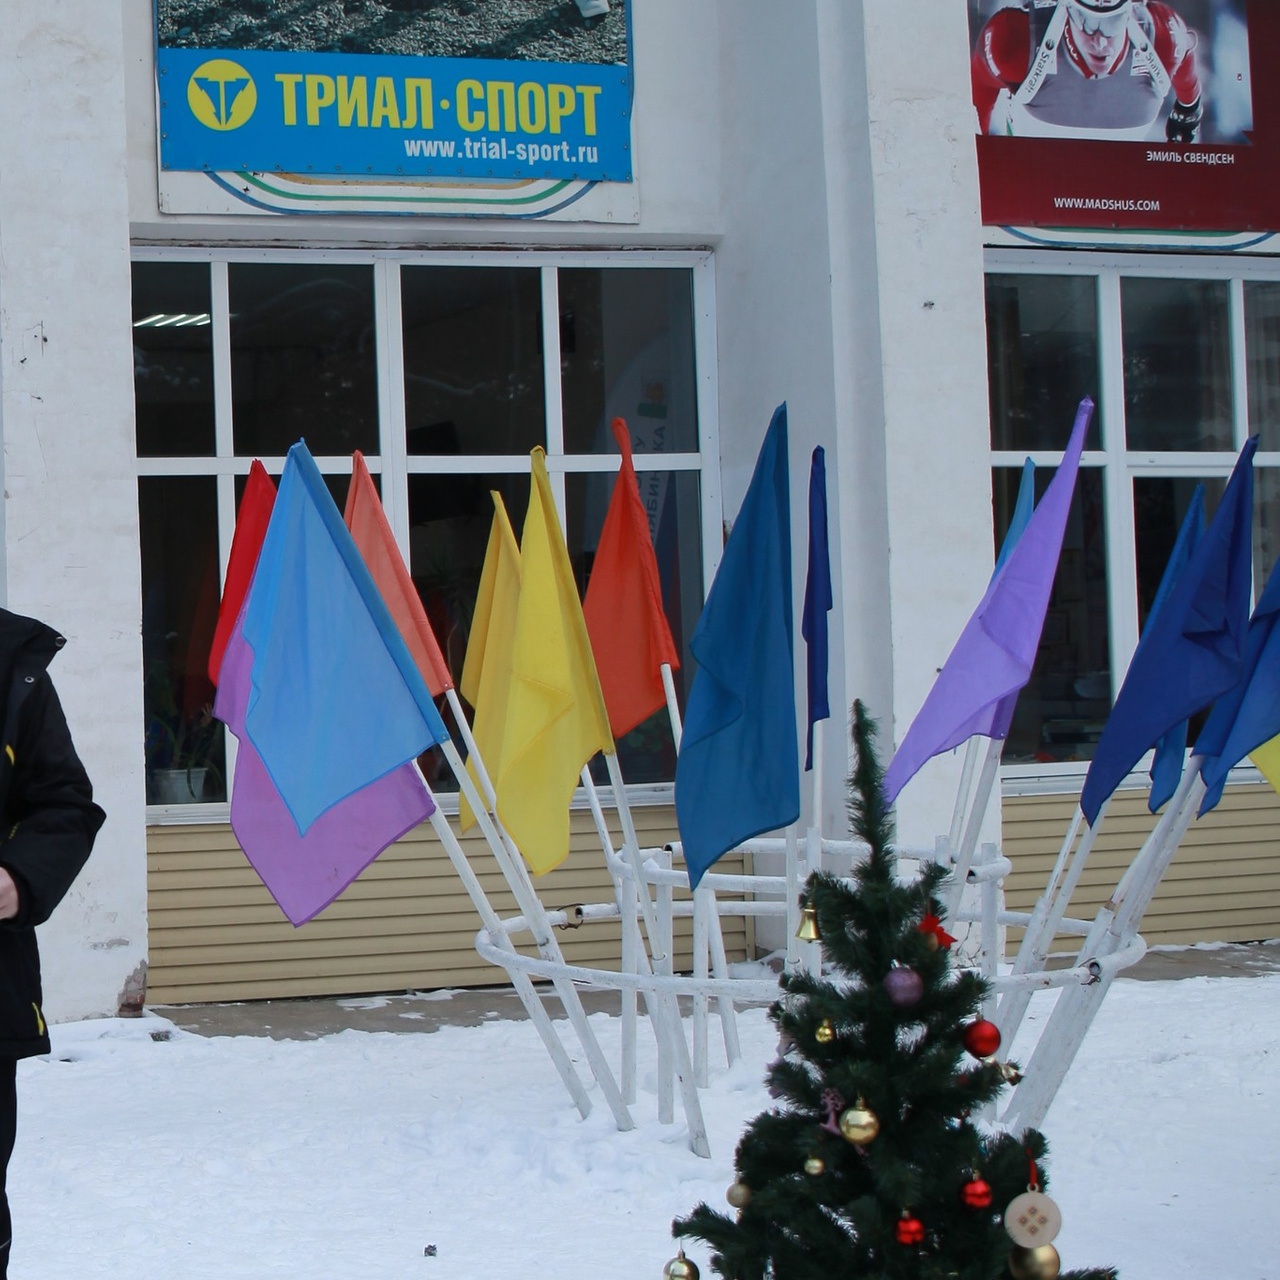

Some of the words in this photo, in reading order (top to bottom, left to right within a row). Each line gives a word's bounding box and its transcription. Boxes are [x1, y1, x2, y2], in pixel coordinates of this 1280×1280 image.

[404, 136, 598, 166] www.trial-sport.ru
[1146, 150, 1182, 164] ЭМИЛЬ
[1183, 151, 1234, 166] СВЕНДСЕН
[1054, 196, 1160, 212] WWW.MADSHUS.COM
